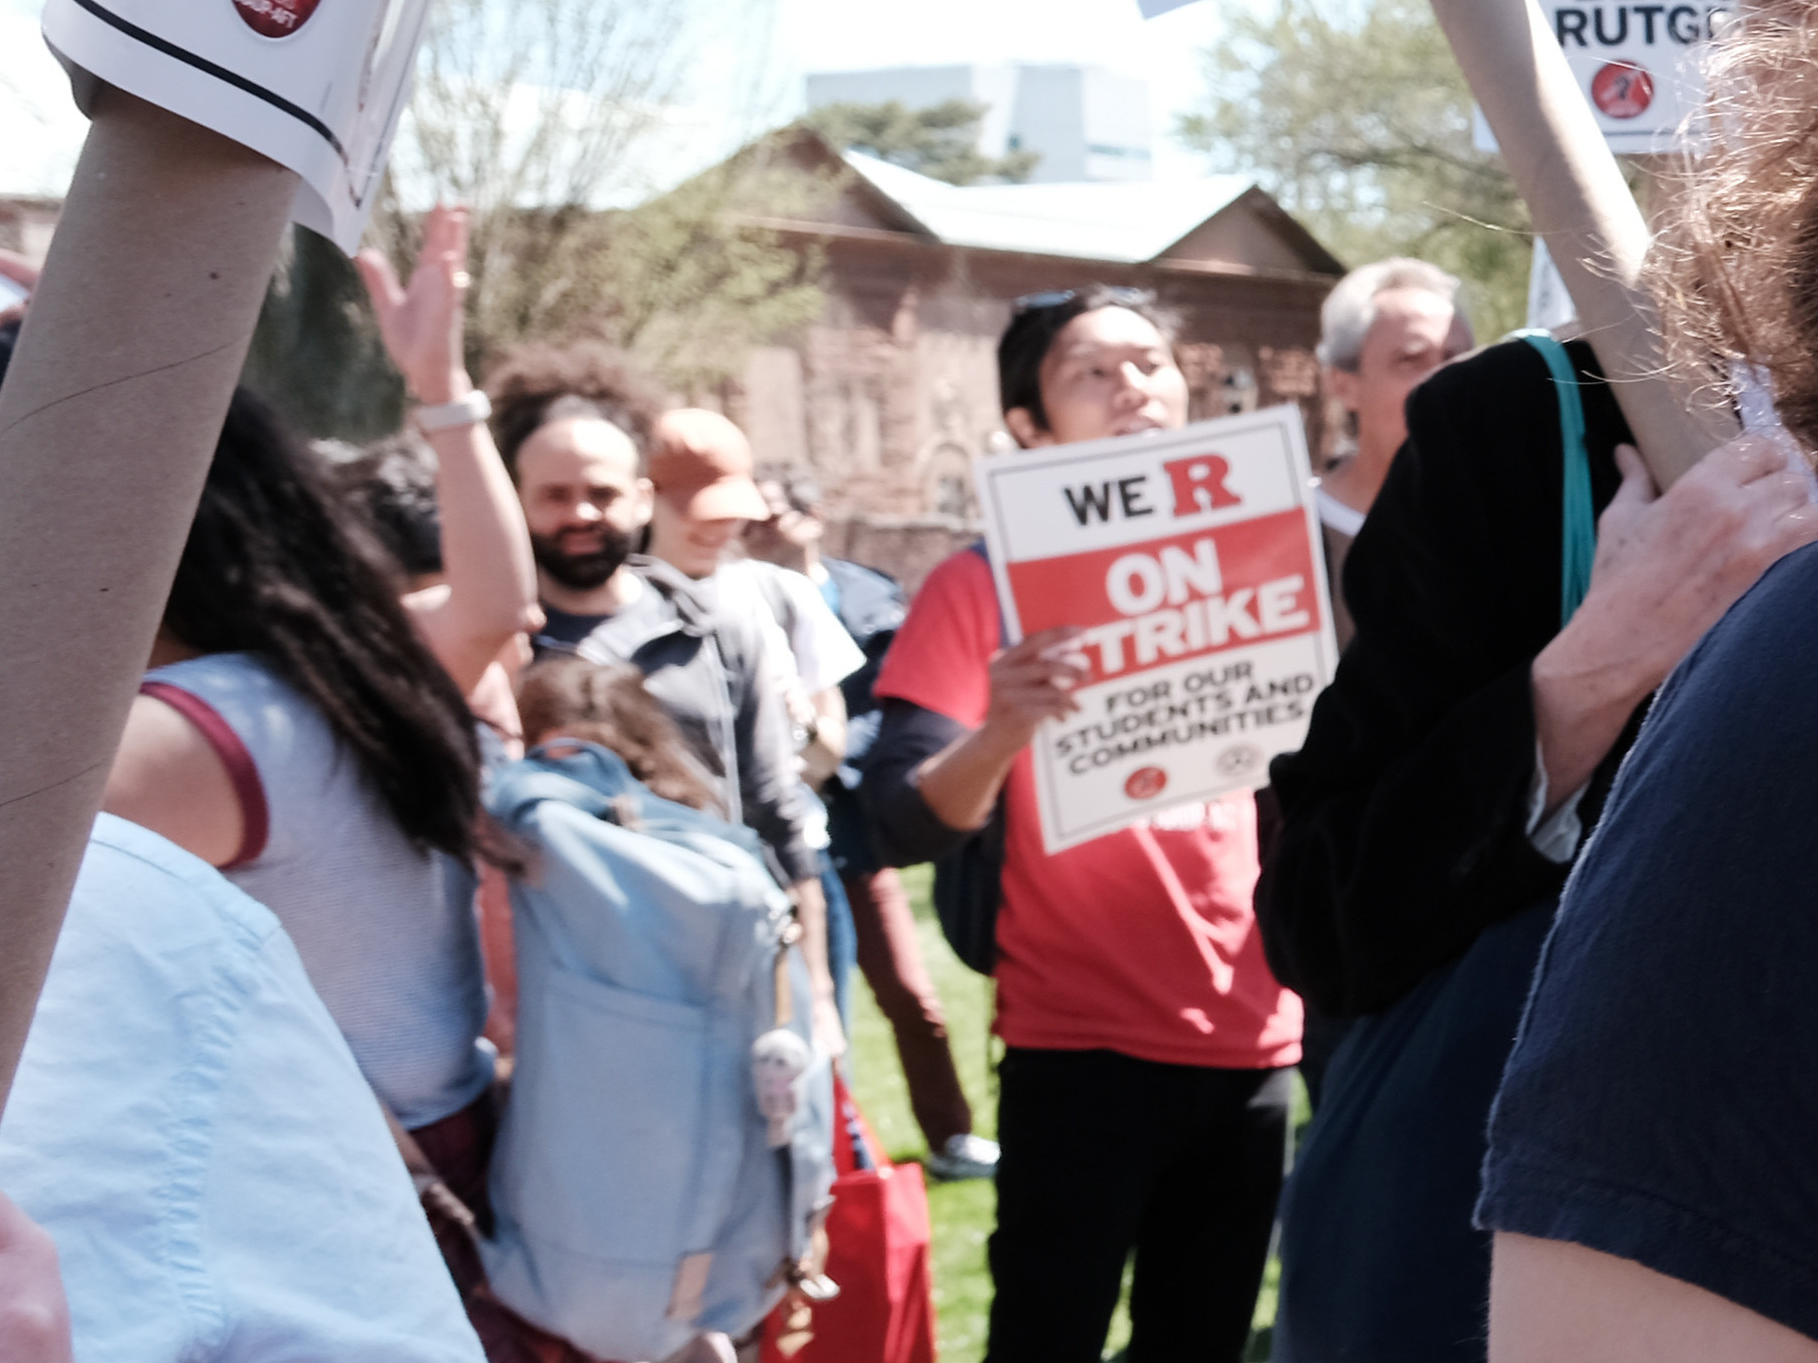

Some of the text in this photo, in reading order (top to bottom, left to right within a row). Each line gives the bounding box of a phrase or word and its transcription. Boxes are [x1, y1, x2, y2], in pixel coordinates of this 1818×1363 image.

[1554, 5, 1727, 48] RUTG
[1064, 453, 1243, 526] WE R
[1105, 539, 1222, 615] ON
[1056, 673, 1314, 757] STUDENTS AND
[1106, 660, 1254, 714] FOR OUR
[1069, 702, 1305, 775] COMMUNITIES
